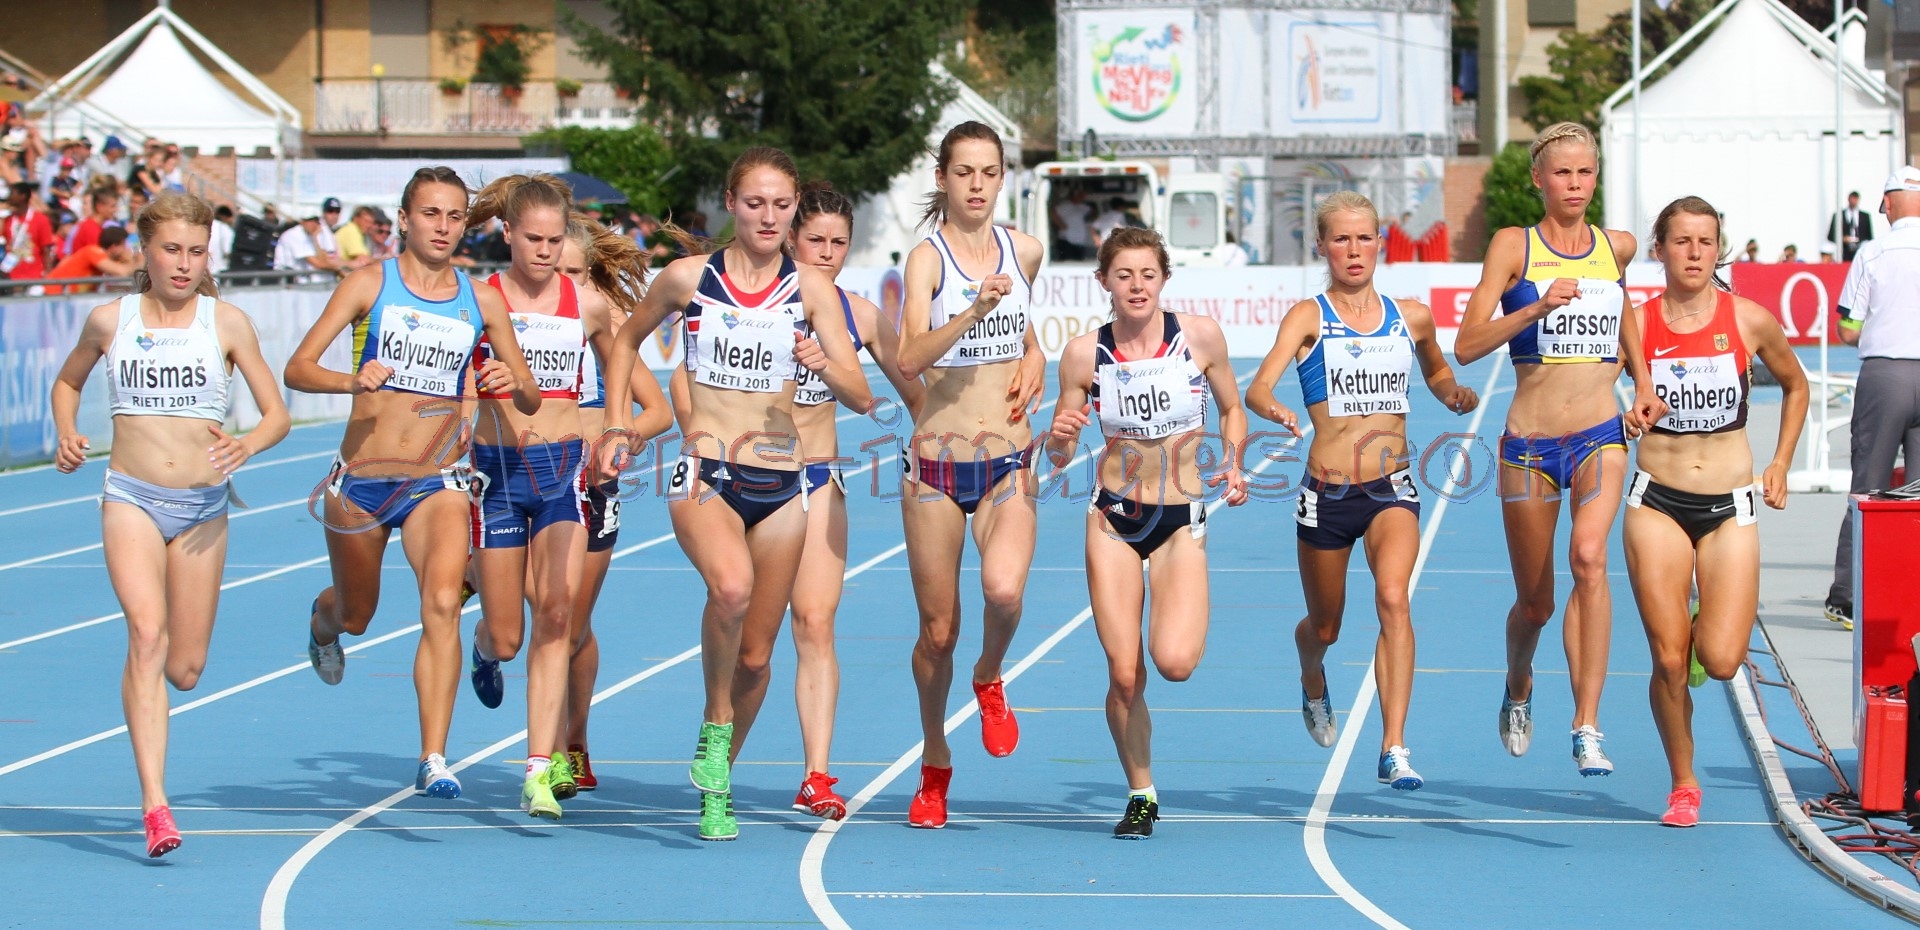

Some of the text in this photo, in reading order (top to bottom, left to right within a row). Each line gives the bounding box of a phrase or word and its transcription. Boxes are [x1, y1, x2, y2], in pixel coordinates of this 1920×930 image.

[420, 321, 454, 334] acea
[530, 319, 562, 331] acea
[739, 318, 775, 330] acea
[1542, 313, 1617, 336] Larsson
[155, 337, 189, 347] acea
[959, 342, 1018, 358] RIETI 2013
[1363, 344, 1395, 354] acea
[1552, 343, 1611, 355] RIETI 2013
[381, 330, 464, 371] Kalyuzhna
[713, 336, 773, 372] Neale
[120, 357, 207, 389] Mišmaš
[1133, 366, 1166, 379] acea
[1688, 364, 1719, 374] acea
[388, 371, 446, 393] RIETI 2013
[538, 377, 562, 388] 2013
[708, 371, 770, 390] RIETI 2013
[1330, 367, 1406, 396] Kettunen
[132, 395, 197, 408] RIETI 2013
[1117, 384, 1171, 422] Ingle
[1655, 382, 1737, 411] Rehberg
[1343, 400, 1402, 413] RIETI 2013
[1119, 420, 1178, 437] RIETI 2013
[1668, 414, 1726, 430] RIETI 2013
[671, 461, 689, 488] 8
[1745, 490, 1755, 516] 1
[490, 527, 519, 535] CRAFT
